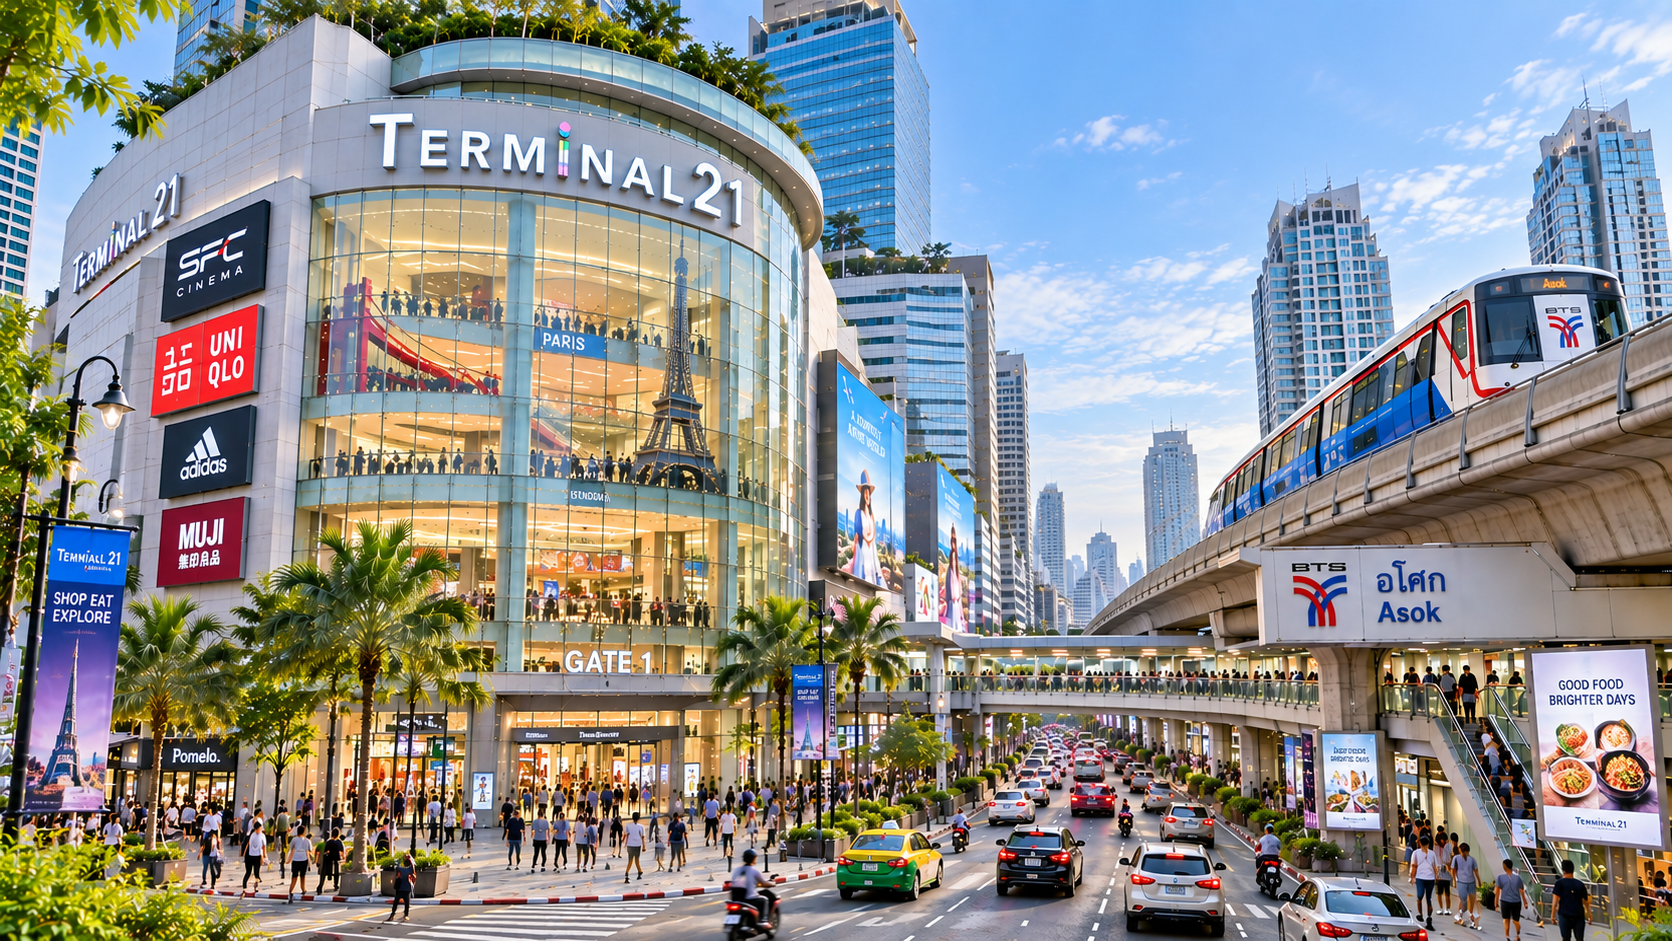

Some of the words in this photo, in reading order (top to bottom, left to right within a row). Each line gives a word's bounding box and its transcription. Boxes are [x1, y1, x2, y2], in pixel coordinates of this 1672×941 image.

[151, 172, 180, 230] 21
[691, 162, 744, 228] 21
[178, 226, 248, 281] SFC
[176, 265, 243, 298] CINEMA
[210, 326, 243, 357] UNI
[542, 332, 585, 351] PARIS
[208, 355, 244, 389] QLO
[180, 457, 227, 481] adidas
[178, 518, 225, 550] MUJI
[107, 550, 121, 566] 21
[1291, 562, 1347, 572] BTS
[1376, 560, 1446, 593] อโศก
[53, 591, 87, 606] SHOP
[90, 594, 114, 608] EAT
[52, 608, 112, 624] EXPLORE
[1377, 600, 1442, 623] Asok
[564, 650, 632, 674] GATE
[640, 651, 651, 674] 1
[1558, 679, 1589, 691] GOOD
[1592, 678, 1624, 691] FOOD
[1549, 694, 1603, 706] BRIGHTER
[1607, 693, 1636, 706] DAYS
[172, 747, 221, 763] Pomelo.
[1617, 819, 1627, 829] 21
